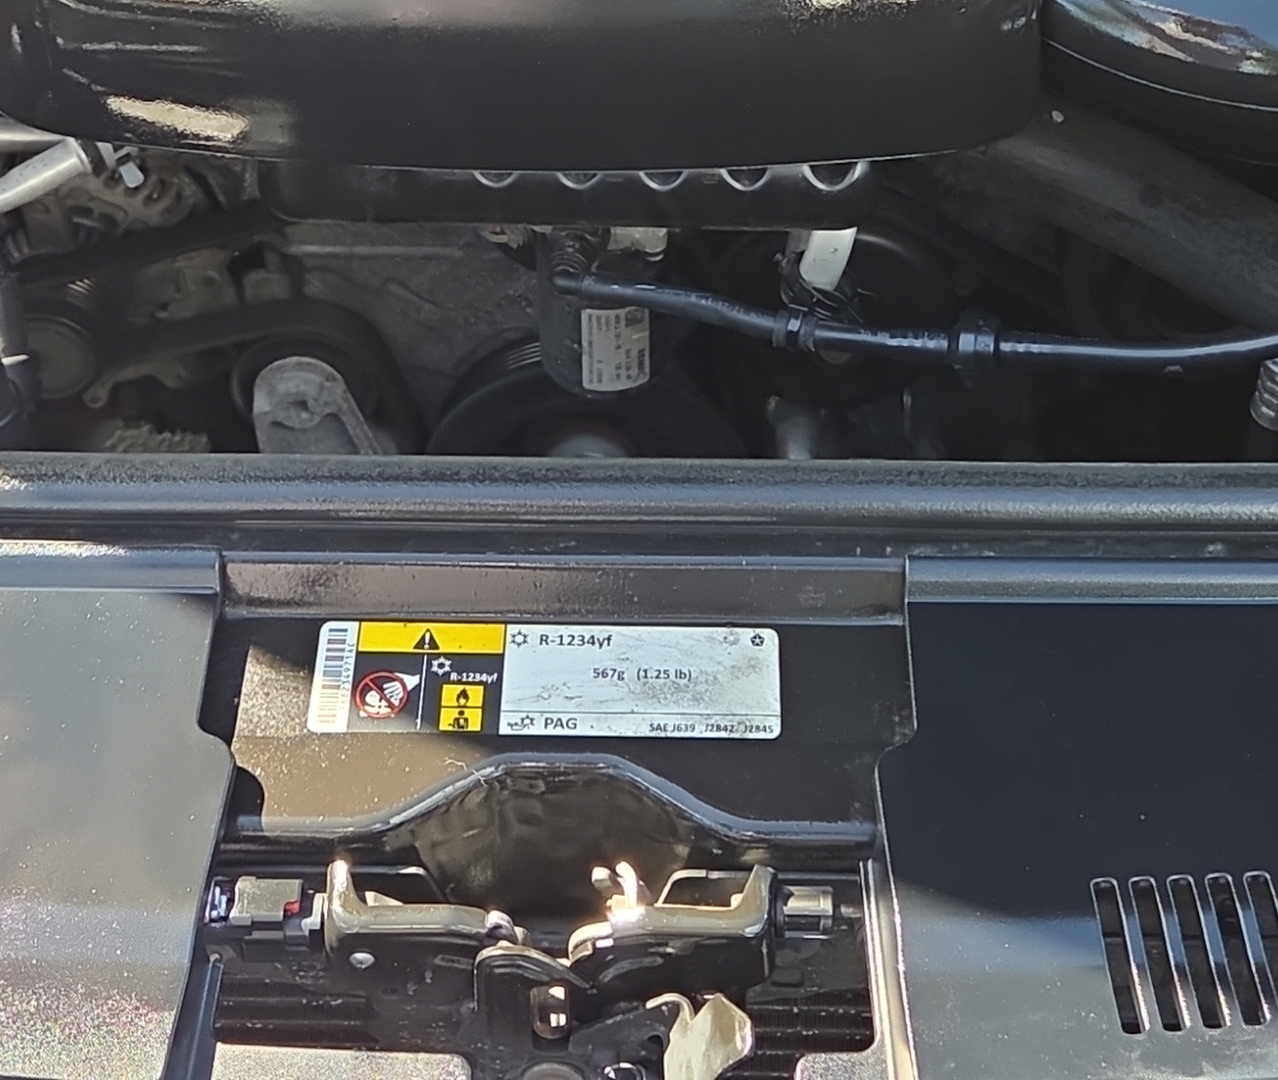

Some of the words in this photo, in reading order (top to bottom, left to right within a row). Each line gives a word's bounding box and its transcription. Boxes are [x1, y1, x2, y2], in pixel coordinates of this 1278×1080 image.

[539, 633, 613, 650] R-1234yf
[450, 672, 498, 684] R-1234yf
[592, 667, 625, 681] 567g
[636, 667, 670, 682] (1.25
[674, 667, 692, 682] lb)
[543, 717, 578, 730] PAG
[649, 723, 669, 733] SAE
[670, 723, 696, 733] J639
[743, 724, 774, 734] J2845
